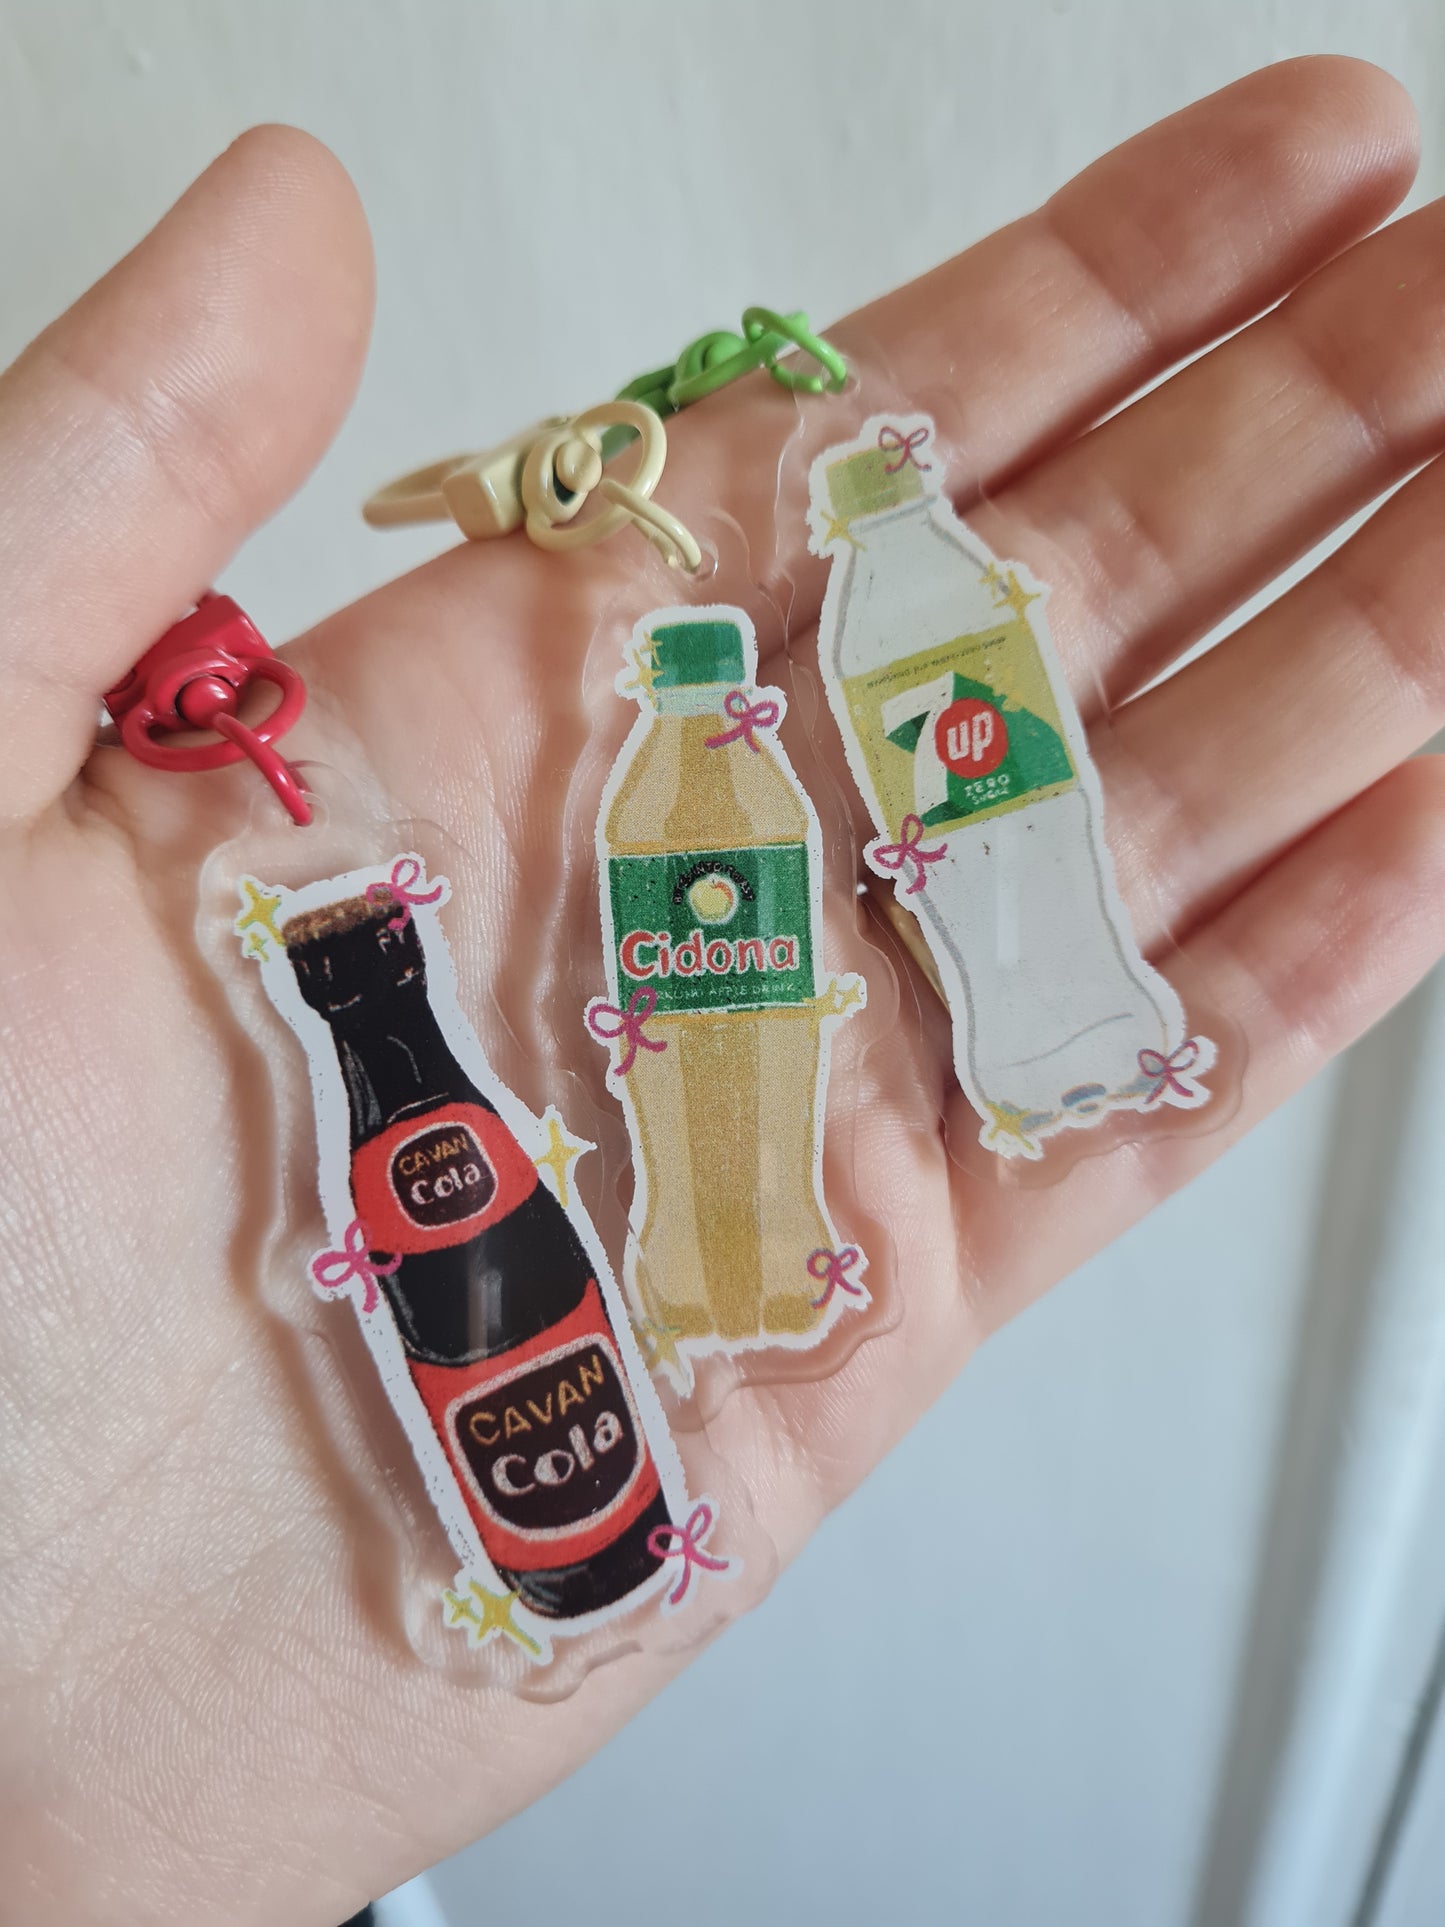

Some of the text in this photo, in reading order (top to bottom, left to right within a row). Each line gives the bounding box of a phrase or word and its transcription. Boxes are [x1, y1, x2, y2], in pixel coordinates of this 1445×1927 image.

[881, 670, 994, 820] 7 up
[964, 773, 1010, 798] ZERO
[619, 929, 799, 981] Cidona
[709, 985, 748, 997] APPLE
[398, 1132, 470, 1176] CAVAN
[410, 1162, 482, 1205] Cola
[469, 1353, 605, 1445] CAVAN
[491, 1410, 624, 1496] Cola
